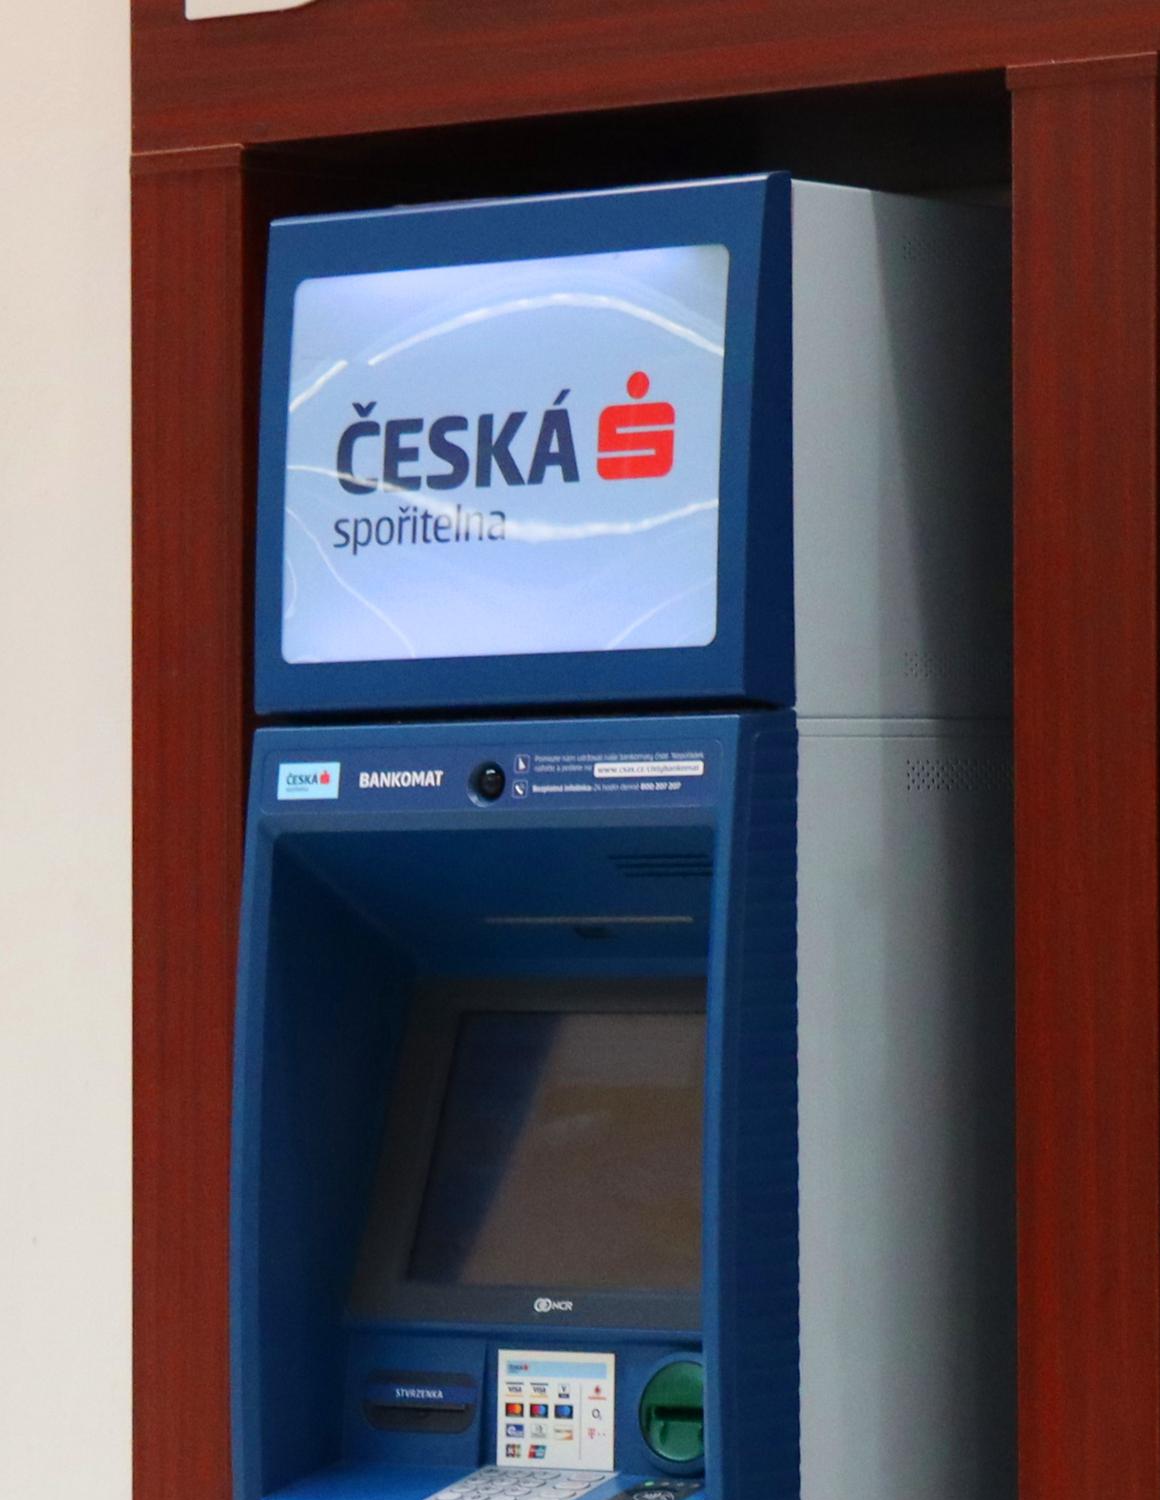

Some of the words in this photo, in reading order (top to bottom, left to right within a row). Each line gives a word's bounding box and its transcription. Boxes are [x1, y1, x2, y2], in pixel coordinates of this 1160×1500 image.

[336, 389, 580, 495] ČESKÁ
[334, 505, 505, 555] spořitelna
[359, 770, 443, 788] BANKOMAT
[552, 1301, 573, 1311] NCR
[395, 1387, 444, 1399] STVRZENKA
